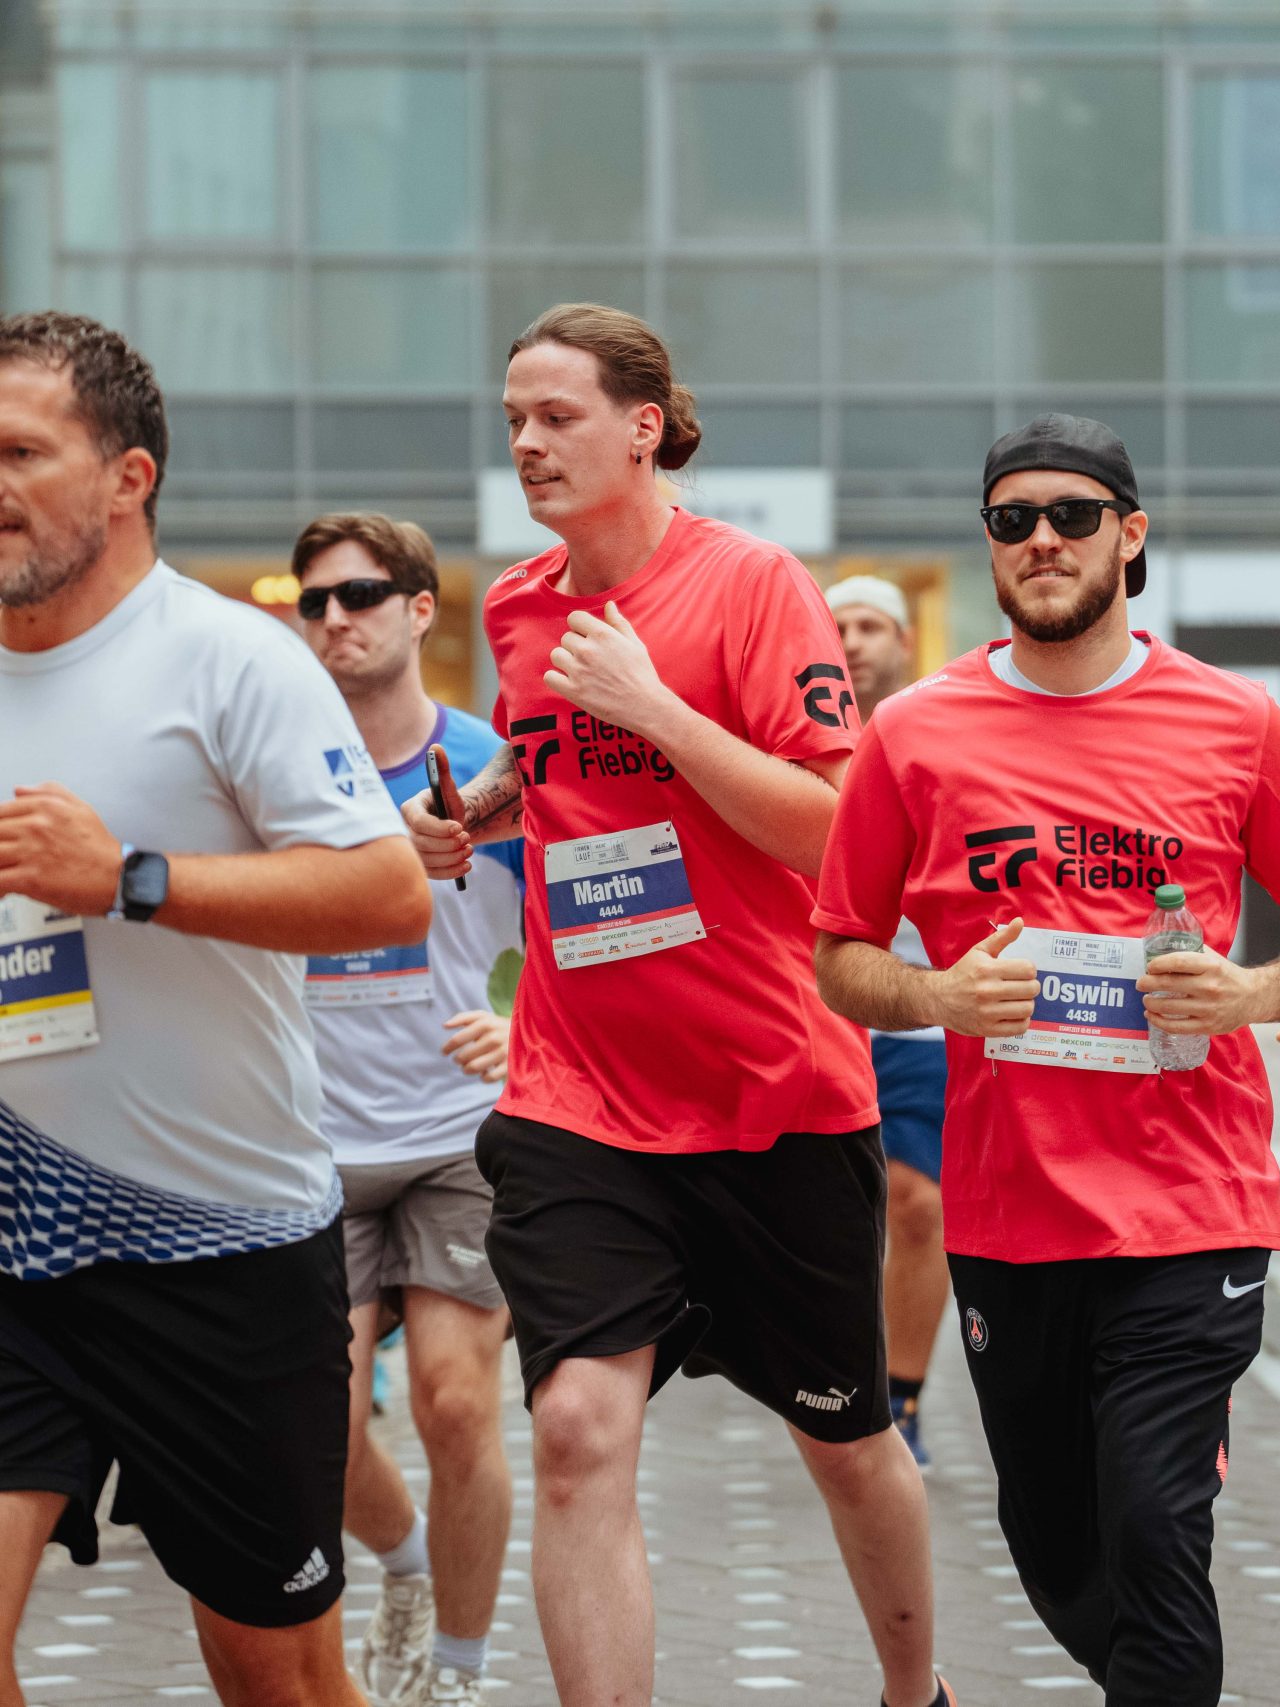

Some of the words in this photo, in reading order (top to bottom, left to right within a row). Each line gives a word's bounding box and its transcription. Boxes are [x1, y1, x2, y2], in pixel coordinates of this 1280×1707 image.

[579, 742, 676, 782] Fiebig
[1054, 824, 1184, 861] Elektro
[575, 851, 592, 862] LAUF
[1056, 858, 1167, 895] Fiebig
[572, 874, 645, 906] Martin
[599, 904, 624, 918] 4444
[1054, 946, 1077, 957] LAUF
[1055, 938, 1078, 947] FIRMEN
[1042, 975, 1124, 1007] Oswin
[1066, 1009, 1097, 1022] 4438
[1001, 1043, 1020, 1052] BDO
[795, 1389, 843, 1411] PUMA
